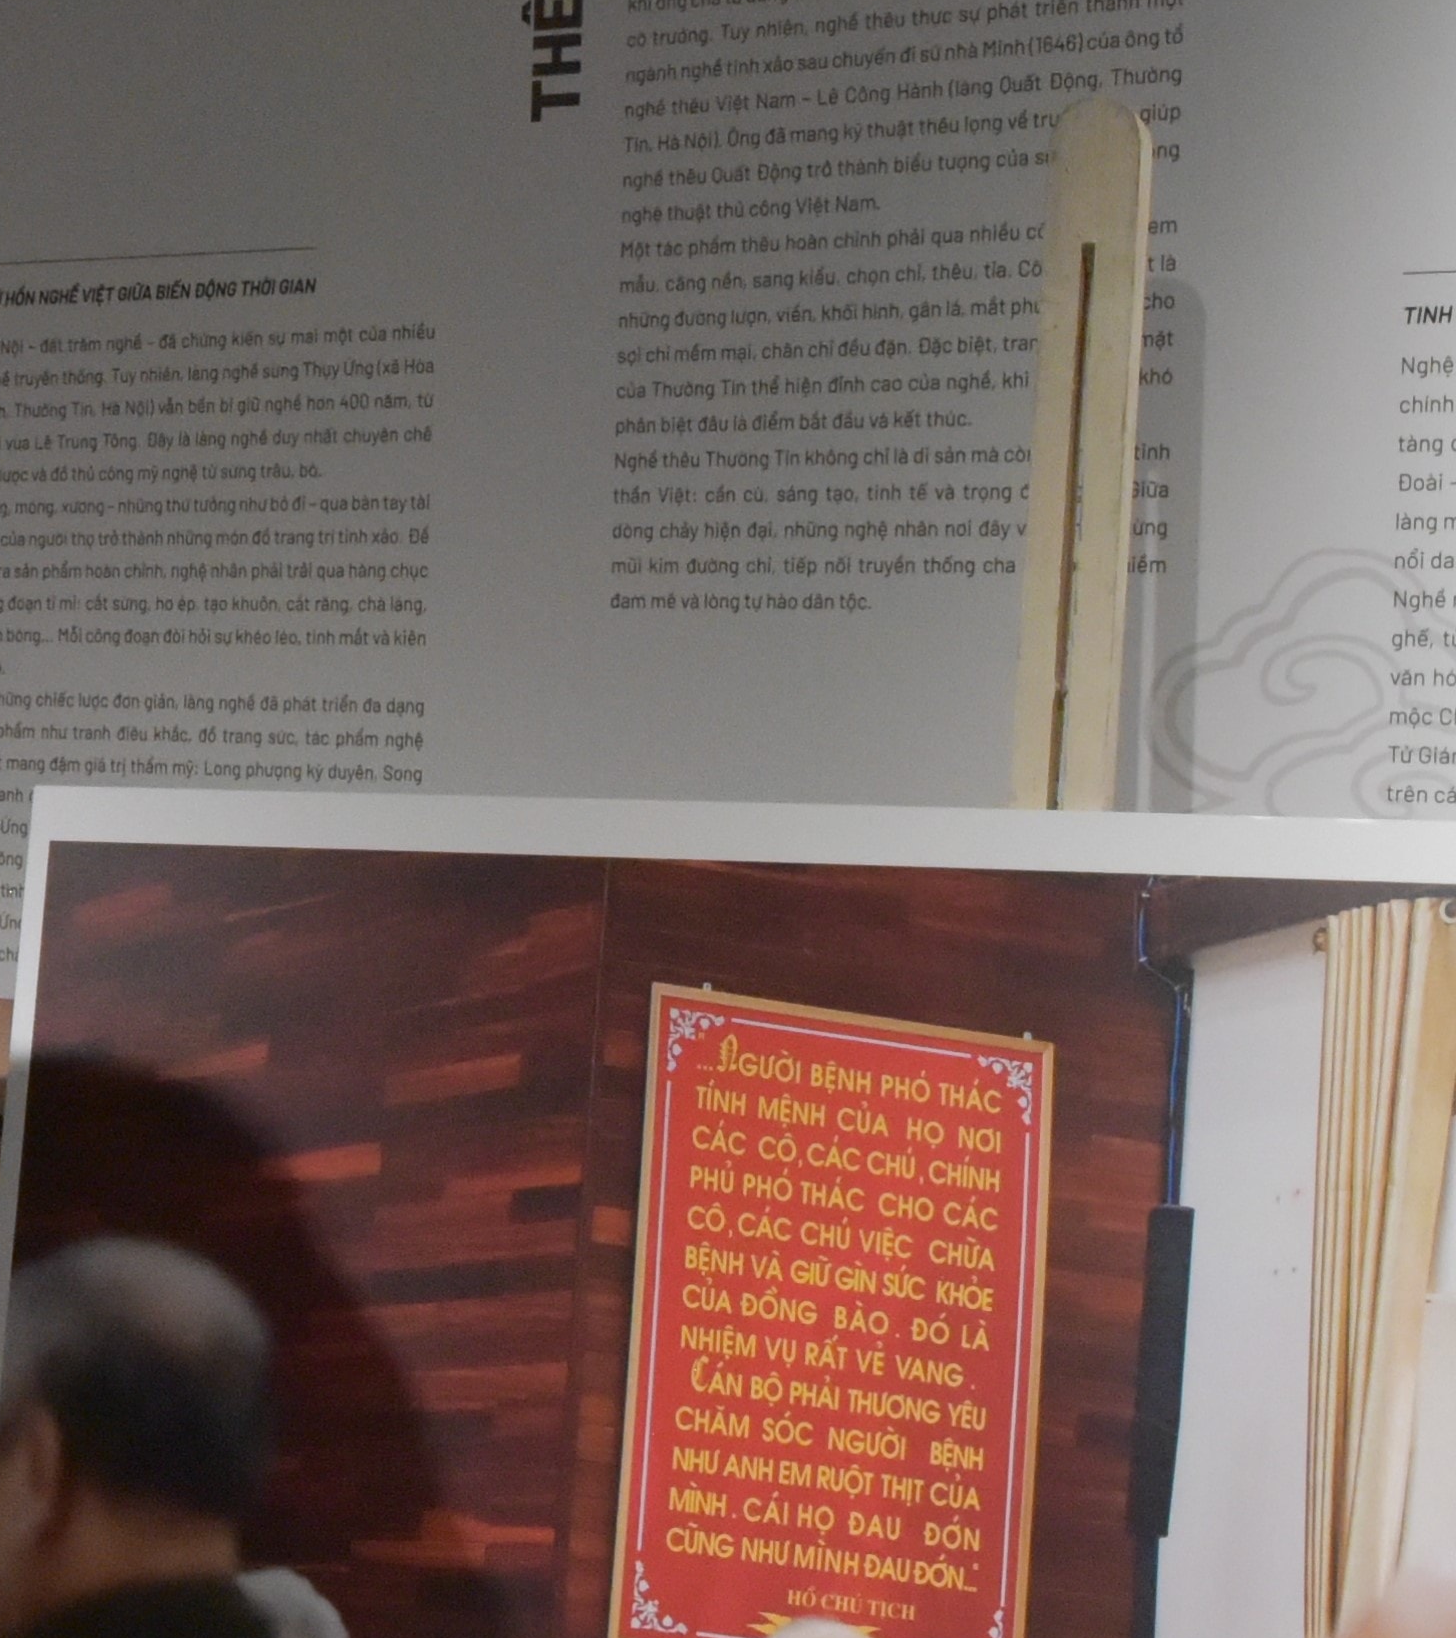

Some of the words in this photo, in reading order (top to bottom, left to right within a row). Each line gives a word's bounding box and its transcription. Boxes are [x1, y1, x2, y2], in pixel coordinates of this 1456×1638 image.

[279, 277, 317, 295] GIAN
[695, 1078, 747, 1116] TÍNH
[757, 1092, 827, 1128] MỆNH
[836, 1100, 889, 1138] CỦA
[905, 1116, 946, 1149] HỌ
[957, 1124, 1002, 1154] NƠI
[809, 1059, 873, 1095] BỆNH
[879, 1069, 932, 1104] PHÓ
[937, 1077, 1002, 1114] THÁC
[691, 1119, 747, 1156] CÁC
[805, 1134, 861, 1172] CÁC
[927, 1155, 1002, 1193] CHÍNH
[689, 1159, 735, 1194] PHỦ
[741, 1167, 794, 1202] PHÓ
[799, 1175, 865, 1212] THÁC
[877, 1191, 936, 1222] CHO
[942, 1195, 998, 1232] CÁC
[736, 1205, 792, 1242] CÁC
[799, 1215, 852, 1251] CHÚ
[858, 1225, 914, 1262] VIỆC
[927, 1235, 995, 1272] CHỮA
[684, 1240, 745, 1276] BỆNH
[750, 1249, 784, 1282] VÀ
[789, 1254, 833, 1288] GIỮ
[833, 1259, 878, 1295] GÌN
[881, 1263, 926, 1301] SỨC
[935, 1274, 994, 1312] KHỎE
[679, 1323, 758, 1360] NHIỆM
[763, 1335, 798, 1368] VỤ
[804, 1333, 849, 1370] RẤT
[855, 1340, 885, 1377] VẺ
[690, 1354, 743, 1398] CÁN
[749, 1370, 784, 1407] BỘ
[788, 1374, 841, 1411] PHẢI
[846, 1387, 942, 1425] THƯƠNG
[947, 1398, 987, 1432] YÊU
[674, 1404, 751, 1439] CHĂM
[761, 1410, 813, 1447] SÓC
[827, 1425, 907, 1460] NGƯỜI
[929, 1436, 985, 1472] BỆNH
[671, 1445, 720, 1475] NHƯ
[722, 1453, 775, 1483] ANH
[777, 1459, 813, 1488] EM
[815, 1463, 875, 1499] RUỘT
[880, 1472, 925, 1507] THỊT
[928, 1472, 981, 1511] CỦA
[786, 1585, 818, 1608] HỒ
